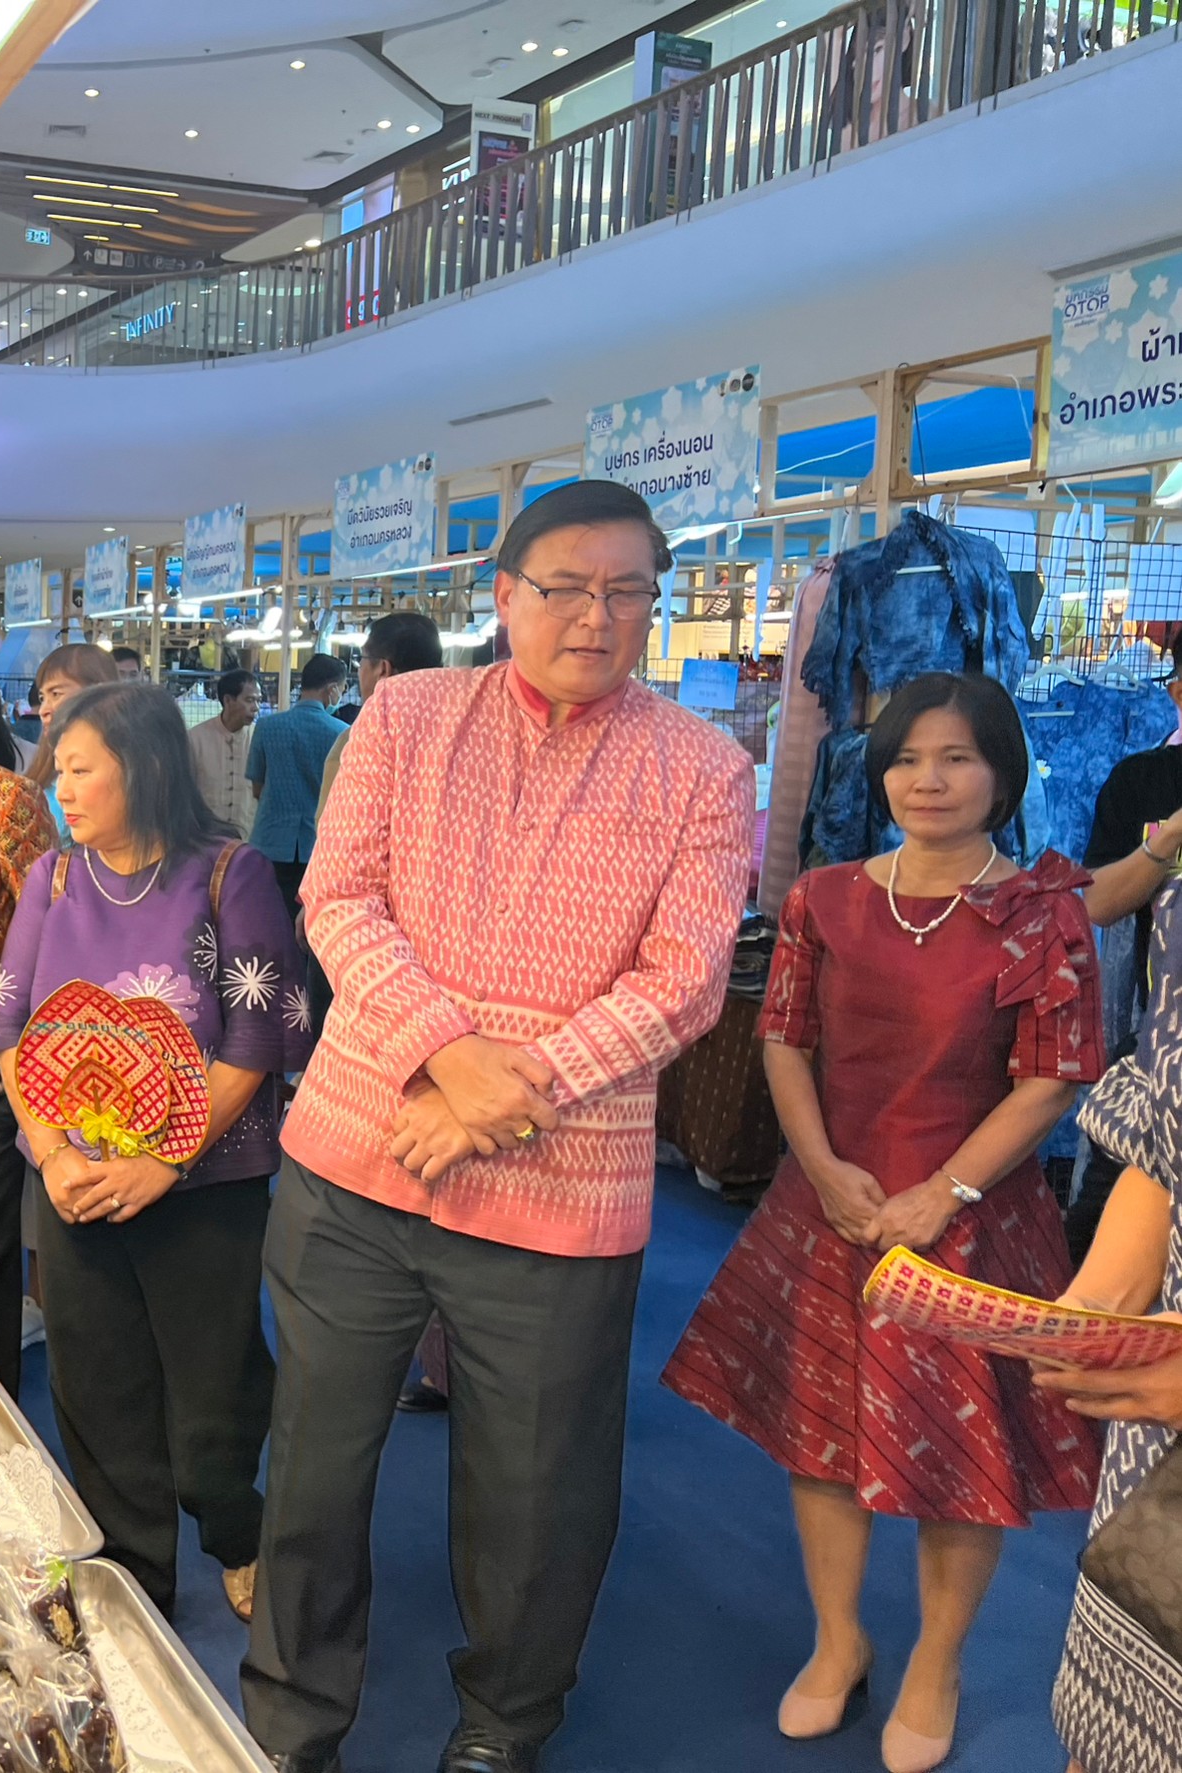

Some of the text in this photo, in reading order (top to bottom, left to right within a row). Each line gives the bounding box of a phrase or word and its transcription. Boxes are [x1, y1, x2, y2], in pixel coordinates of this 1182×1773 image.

[125, 303, 176, 341] INFINITY
[1064, 294, 1110, 318] OTOP
[1141, 327, 1182, 362] ผ้า
[604, 431, 714, 478] บุษกร เครื่องนอน
[623, 465, 711, 496] ำเภอบางซ้าย
